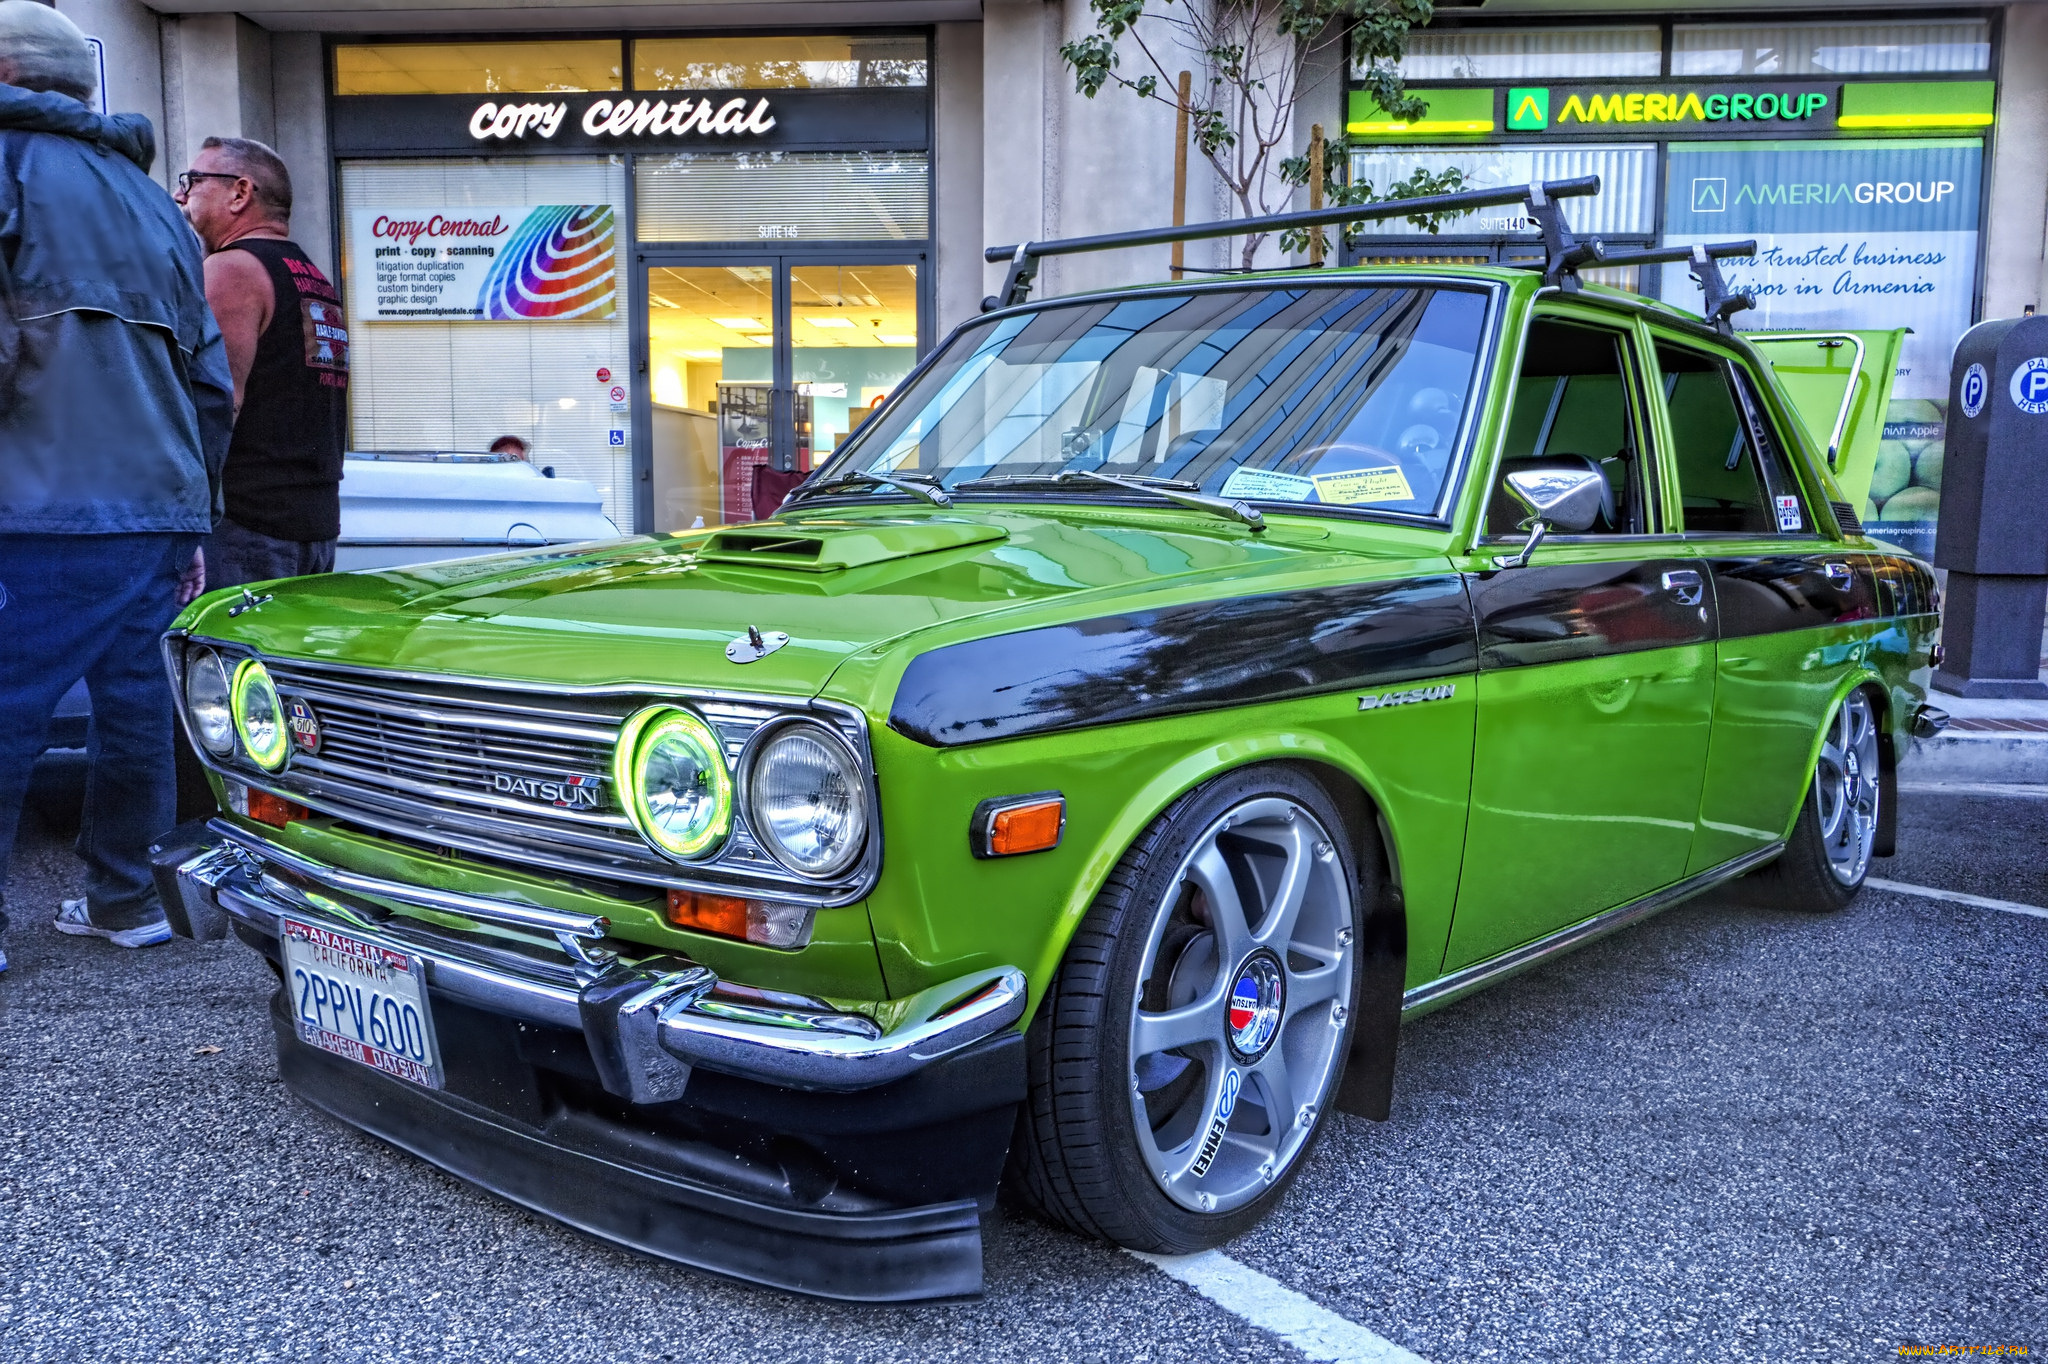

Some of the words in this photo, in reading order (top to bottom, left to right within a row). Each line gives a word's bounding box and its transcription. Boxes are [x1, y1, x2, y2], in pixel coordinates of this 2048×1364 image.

[372, 215, 427, 246] Copy
[427, 214, 509, 237] Central
[1480, 217, 1504, 230] SUITE
[1505, 217, 1526, 230] 140
[759, 225, 782, 238] SUITE
[784, 225, 798, 238] 145
[375, 246, 401, 258] print
[411, 247, 436, 258] copy
[446, 245, 494, 258] scanning
[1717, 255, 1760, 268] our
[1762, 242, 1849, 267] trusted
[1853, 240, 1946, 266] business
[376, 261, 415, 273] litigation
[416, 261, 464, 273] duplication
[376, 272, 398, 284] large
[399, 272, 426, 282] format
[428, 272, 456, 284] copies
[1794, 276, 1823, 296] in
[1832, 270, 1936, 295] Armenia
[377, 284, 409, 293] custom
[411, 283, 444, 295] bindery
[377, 294, 409, 306] graphic
[410, 294, 438, 306] design
[378, 307, 484, 317] www.copycentralglendale.com
[1969, 364, 1983, 376] PAY
[2027, 358, 2048, 371] PA
[1968, 376, 1981, 405] P
[1963, 403, 1982, 417] HERE
[2017, 398, 2048, 413] HER
[1909, 424, 1940, 438] Apple
[1358, 684, 1456, 710] DATSUN
[296, 717, 311, 734] 510
[495, 774, 597, 806] DATSUN
[313, 945, 388, 983] CALIFORNIA
[1231, 997, 1257, 1010] DATSUN
[294, 966, 426, 1063] 2PPV600
[304, 1025, 366, 1062] ANAHEIM
[373, 1048, 431, 1086] DATSUN
[1192, 1120, 1226, 1177] ENKEI
